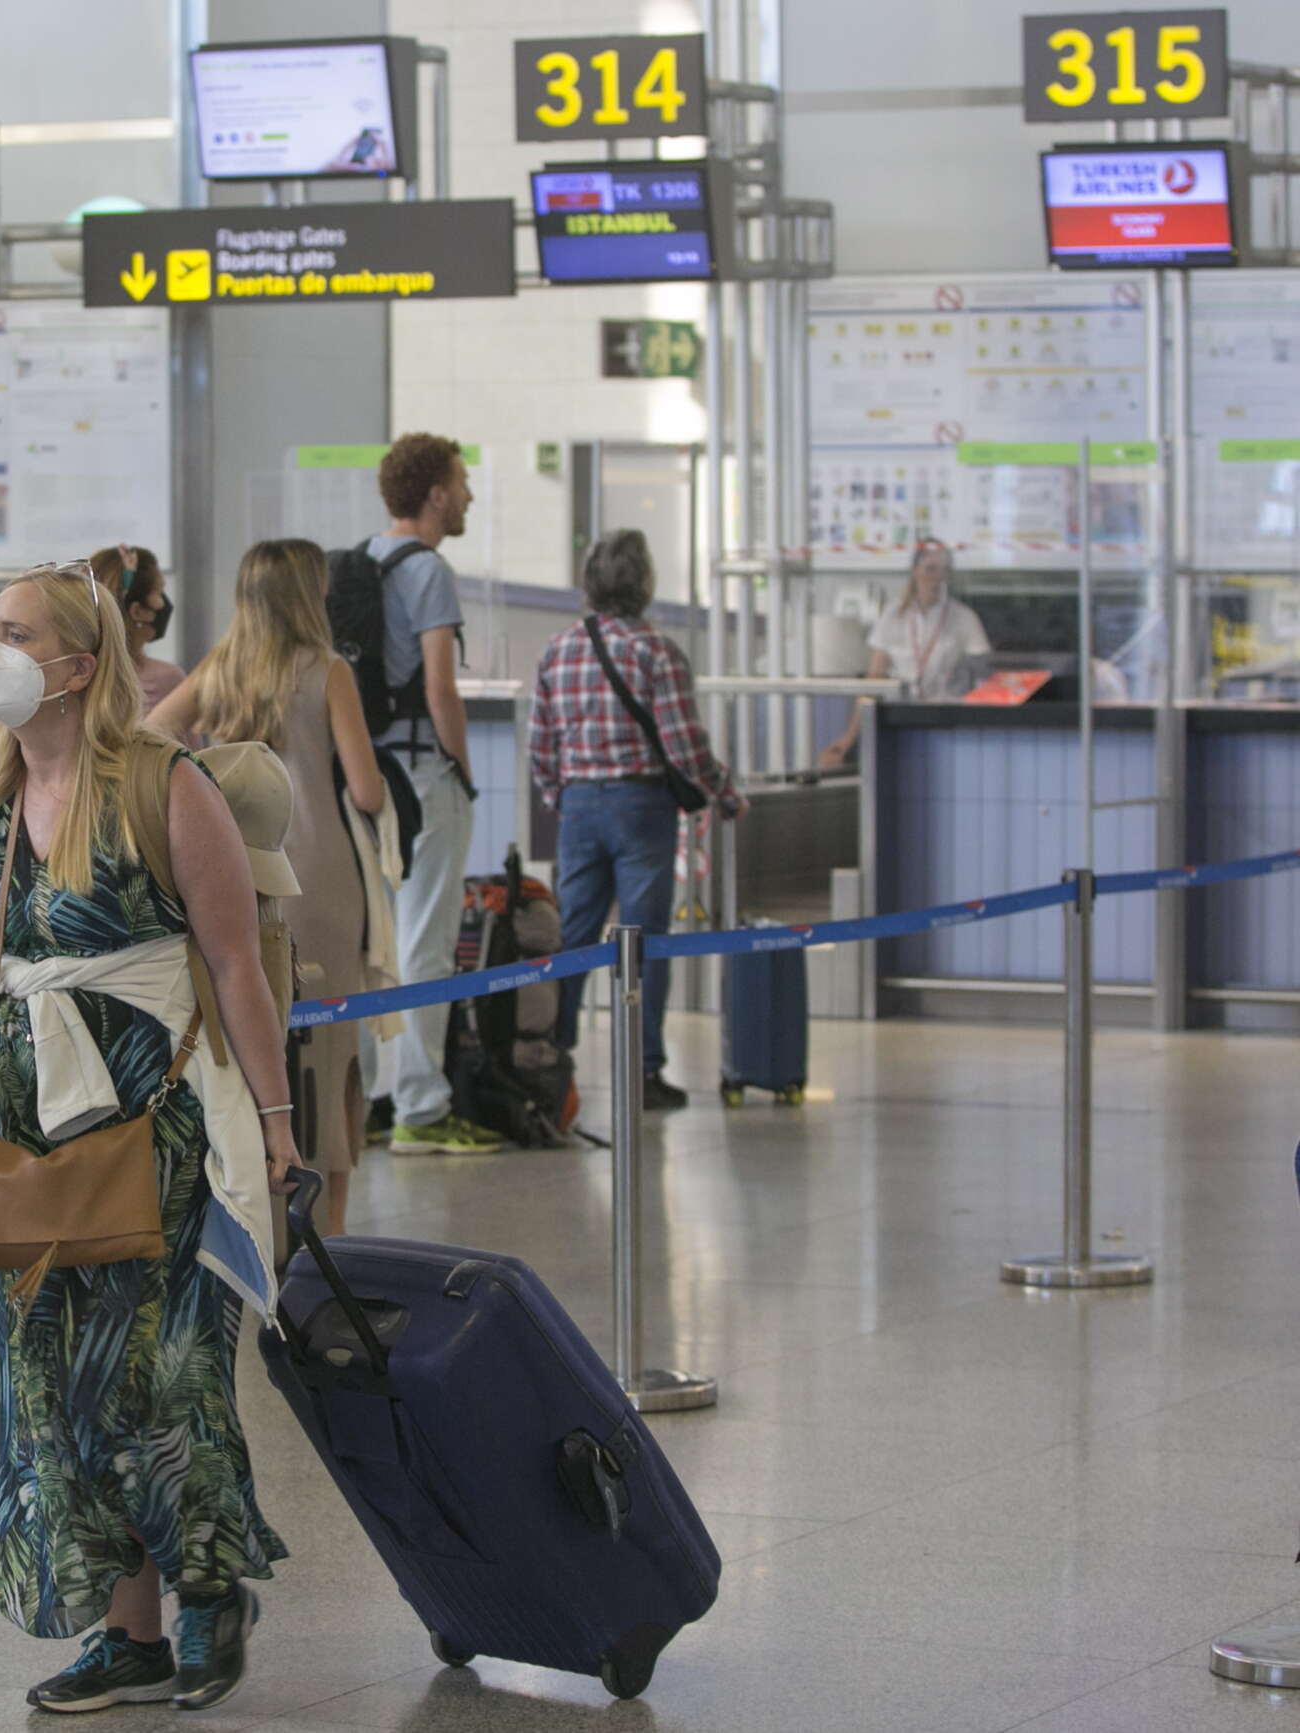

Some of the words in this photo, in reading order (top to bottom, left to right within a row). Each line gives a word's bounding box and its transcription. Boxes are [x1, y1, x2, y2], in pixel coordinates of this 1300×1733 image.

[1045, 26, 1205, 108] 315
[535, 48, 685, 128] 314
[1071, 161, 1158, 178] TURKISH
[614, 182, 642, 201] TK
[1073, 180, 1158, 196] AIRLINES
[565, 212, 677, 235] ISTANBUL
[216, 228, 297, 251] Flugsteige
[300, 226, 347, 247] Gates
[216, 250, 287, 274] Boarding
[290, 251, 336, 273] gates
[216, 273, 297, 297] Puertas
[299, 271, 327, 295] de
[329, 269, 435, 296] embarque
